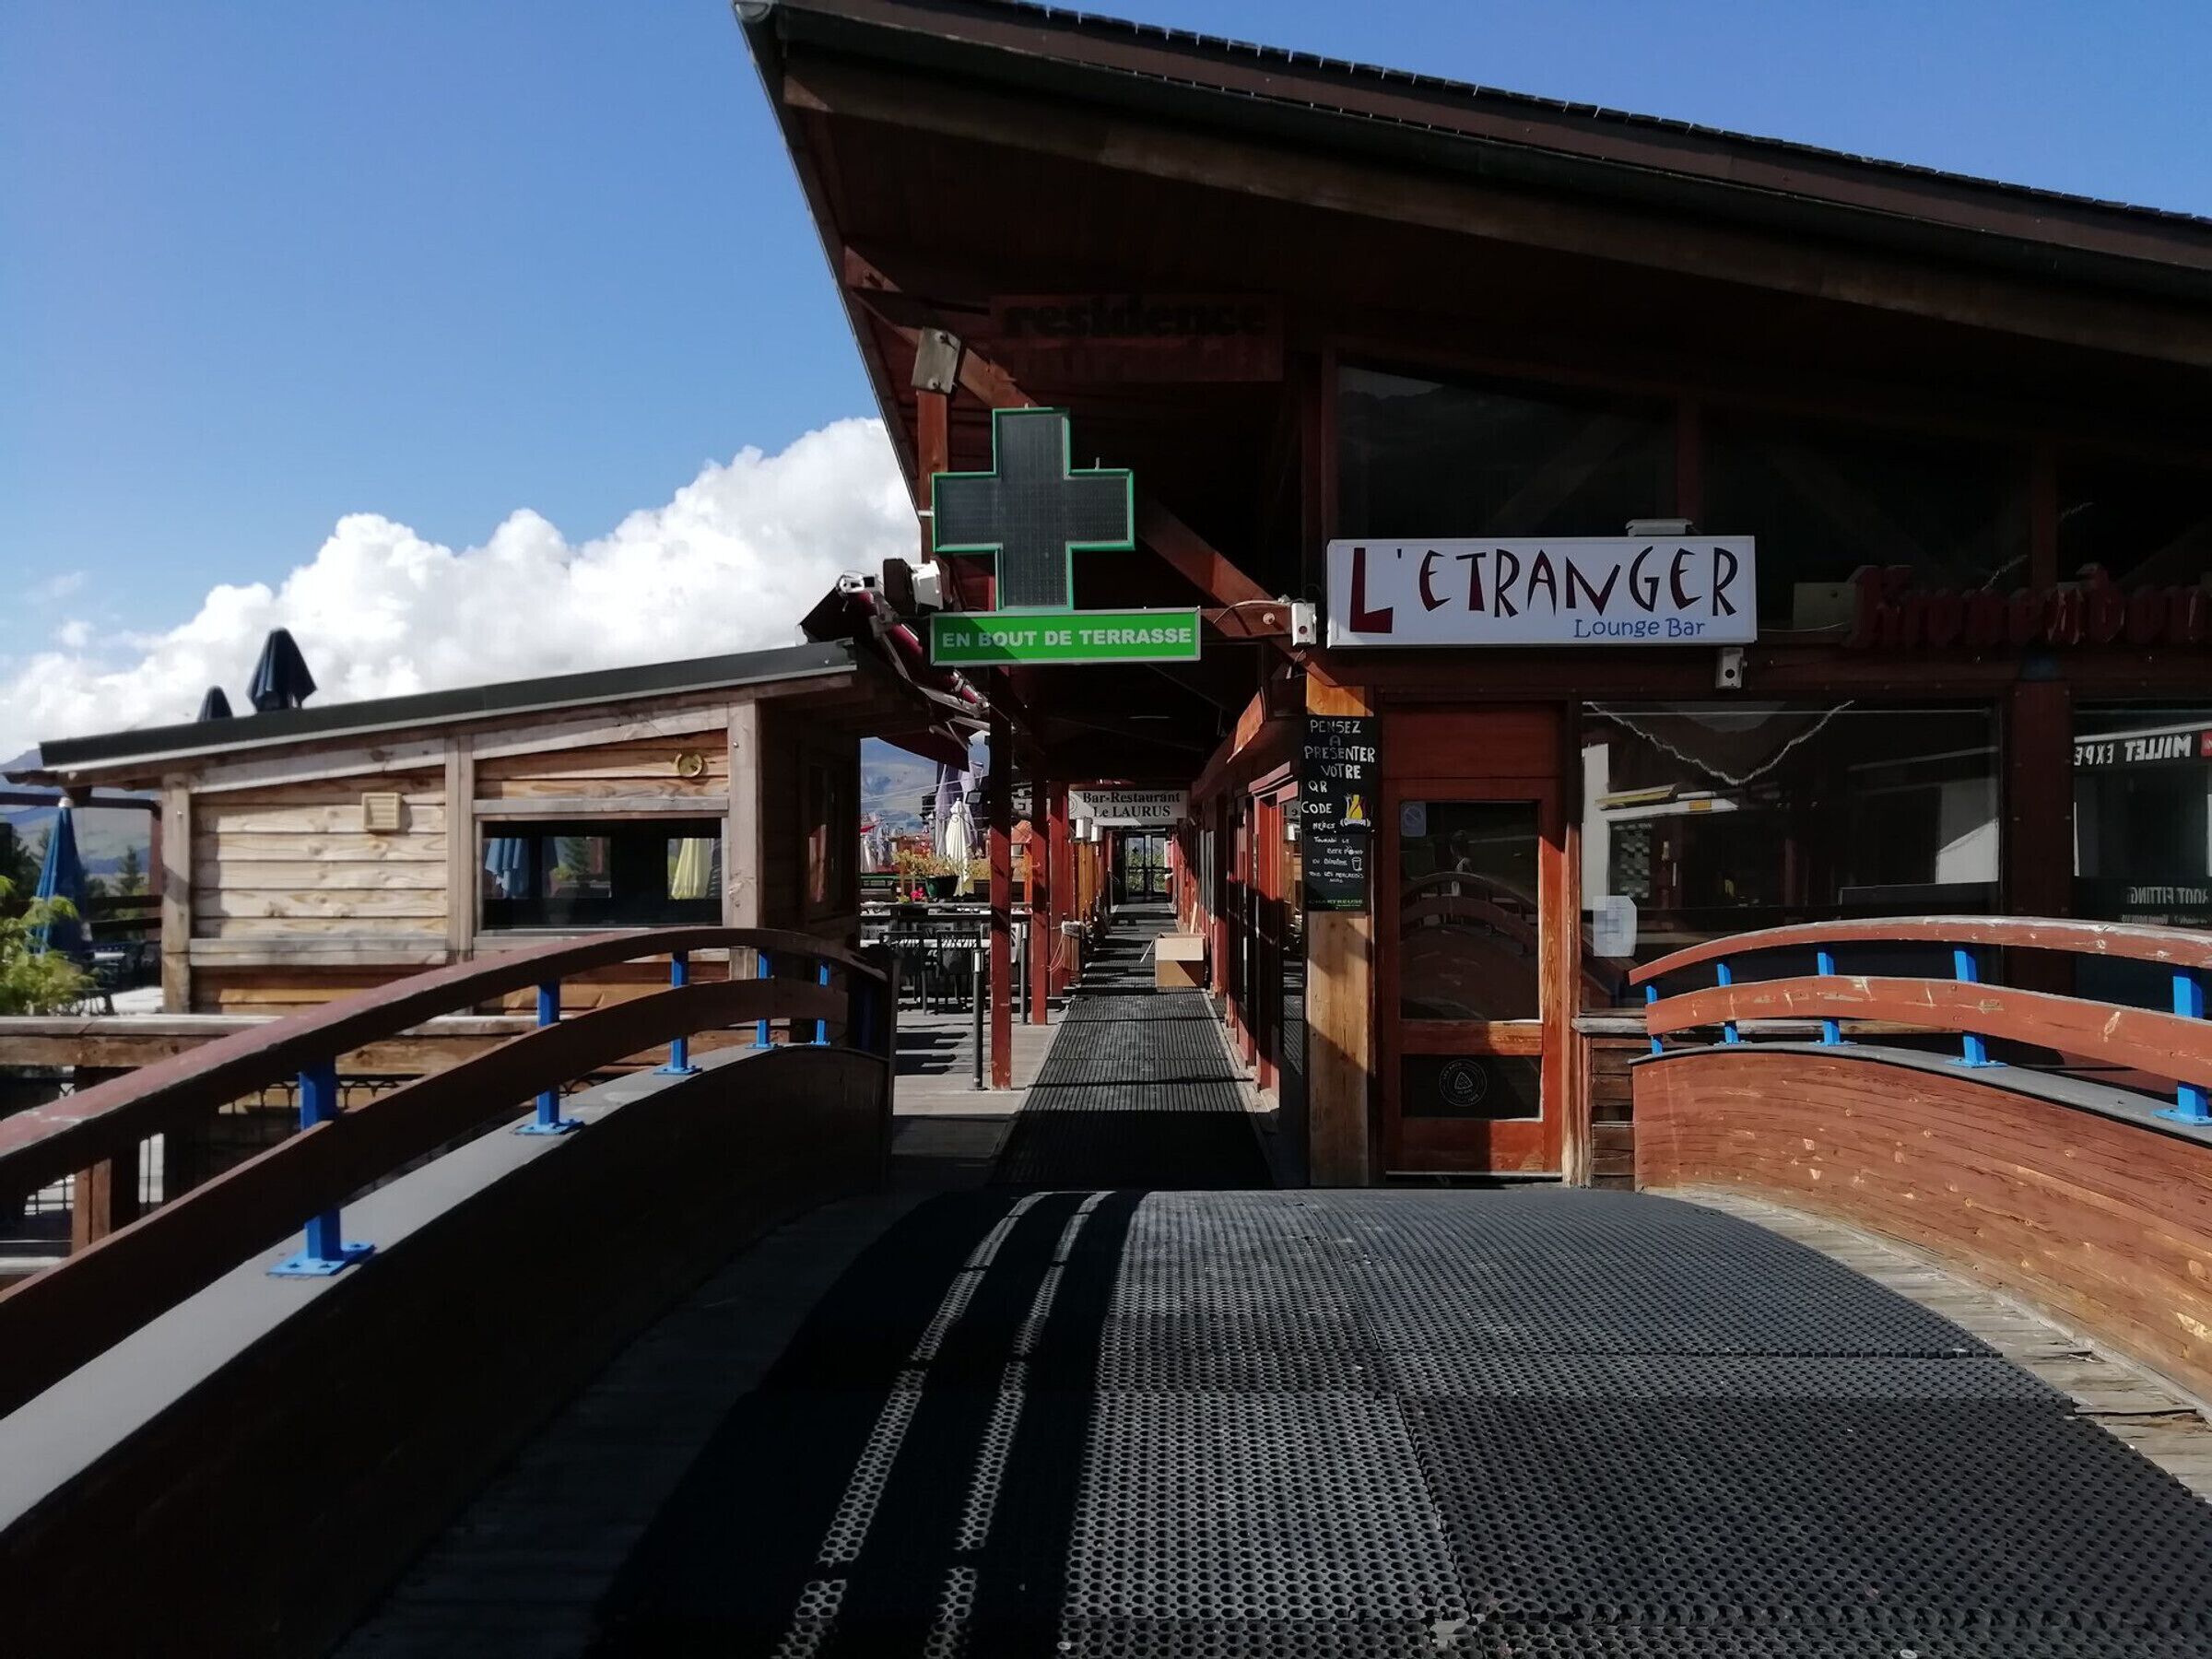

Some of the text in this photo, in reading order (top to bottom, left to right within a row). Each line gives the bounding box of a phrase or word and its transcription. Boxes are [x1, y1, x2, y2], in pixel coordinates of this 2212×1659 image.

[1349, 546, 1738, 634] L'ETRANGER
[1574, 618, 1706, 638] Lounge Bar
[942, 628, 1192, 648] EN BOUT DE TERRASSE
[1310, 719, 1361, 734] PENSEZ
[1304, 746, 1376, 763] PRESENTER
[1321, 763, 1361, 780] VOTRE
[1308, 780, 1327, 793] QR
[1082, 792, 1181, 803] Bar-Restaurant
[1094, 806, 1171, 817] Le LAURUS
[1301, 801, 1333, 814] CODE
